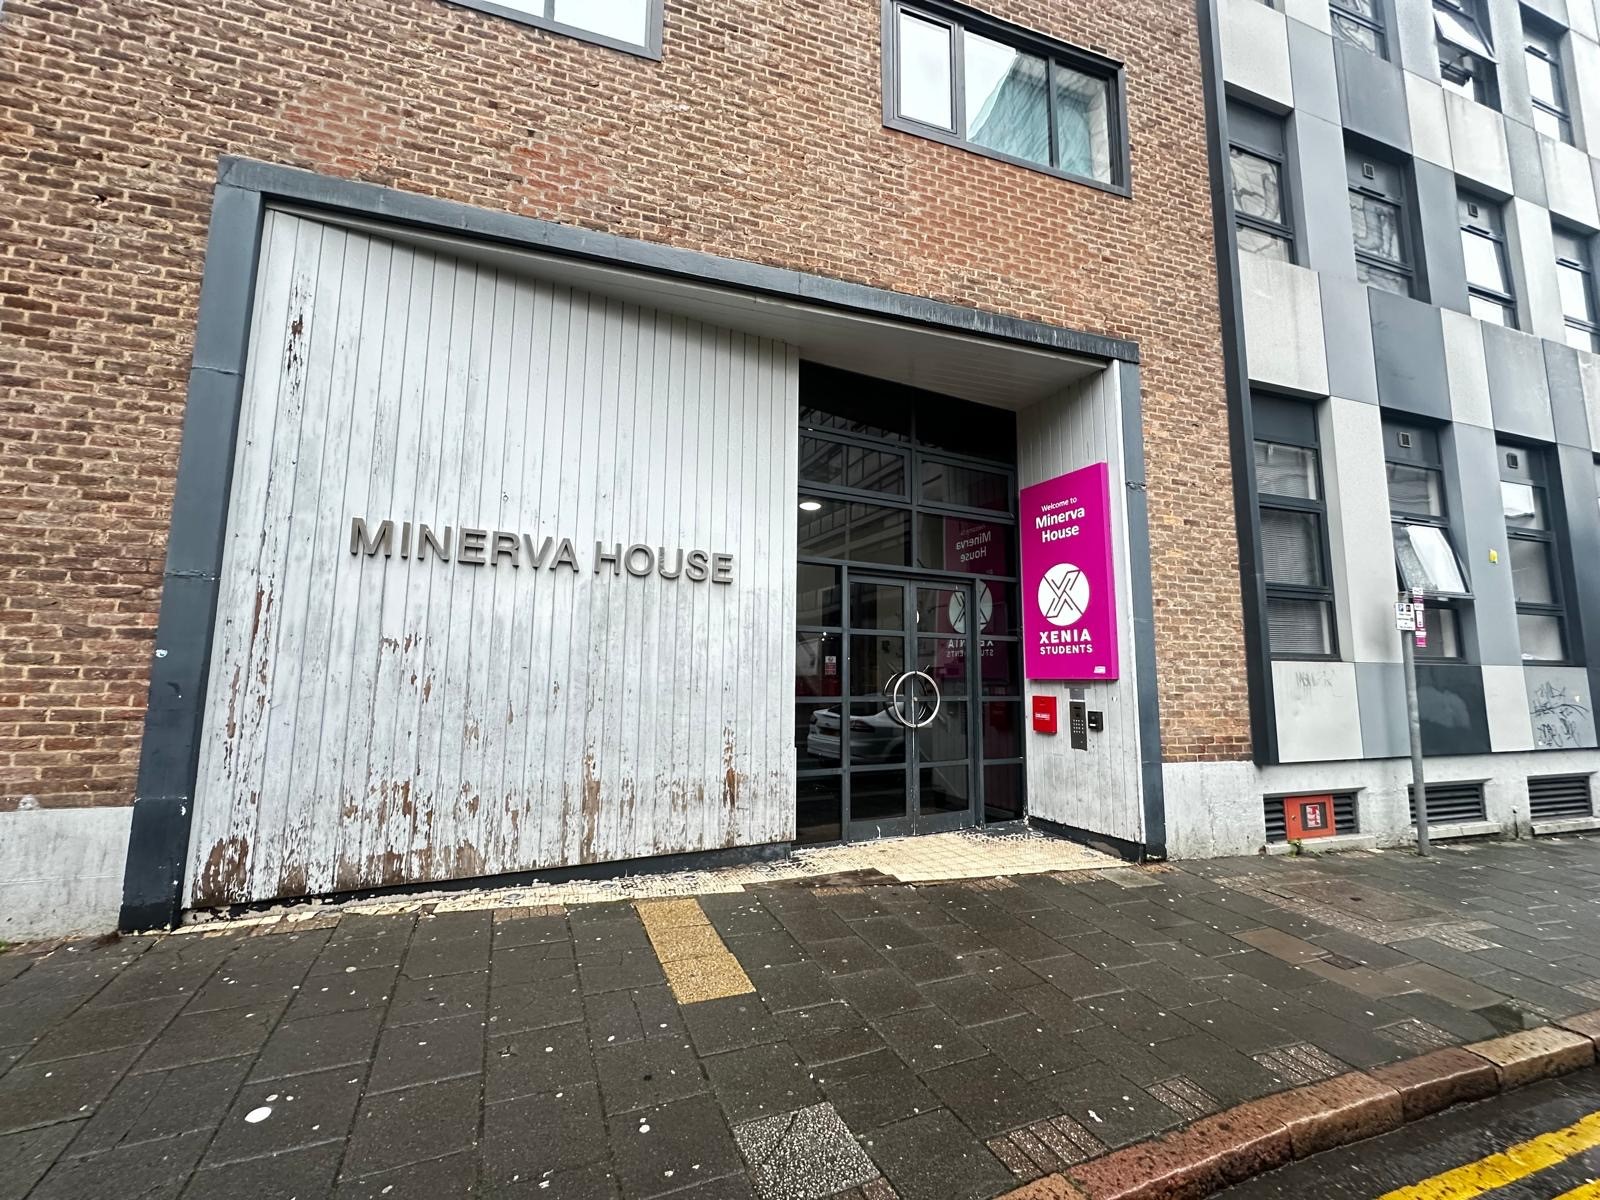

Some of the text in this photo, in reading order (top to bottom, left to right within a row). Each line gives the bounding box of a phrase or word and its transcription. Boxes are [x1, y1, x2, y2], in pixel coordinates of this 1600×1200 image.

[1041, 499, 1069, 512] Welcome
[1035, 507, 1085, 529] Minerva
[1042, 525, 1080, 543] House
[350, 516, 734, 584] MINERVA HOUSE
[1039, 628, 1092, 644] XENIA
[1040, 644, 1093, 655] STUDENTS
